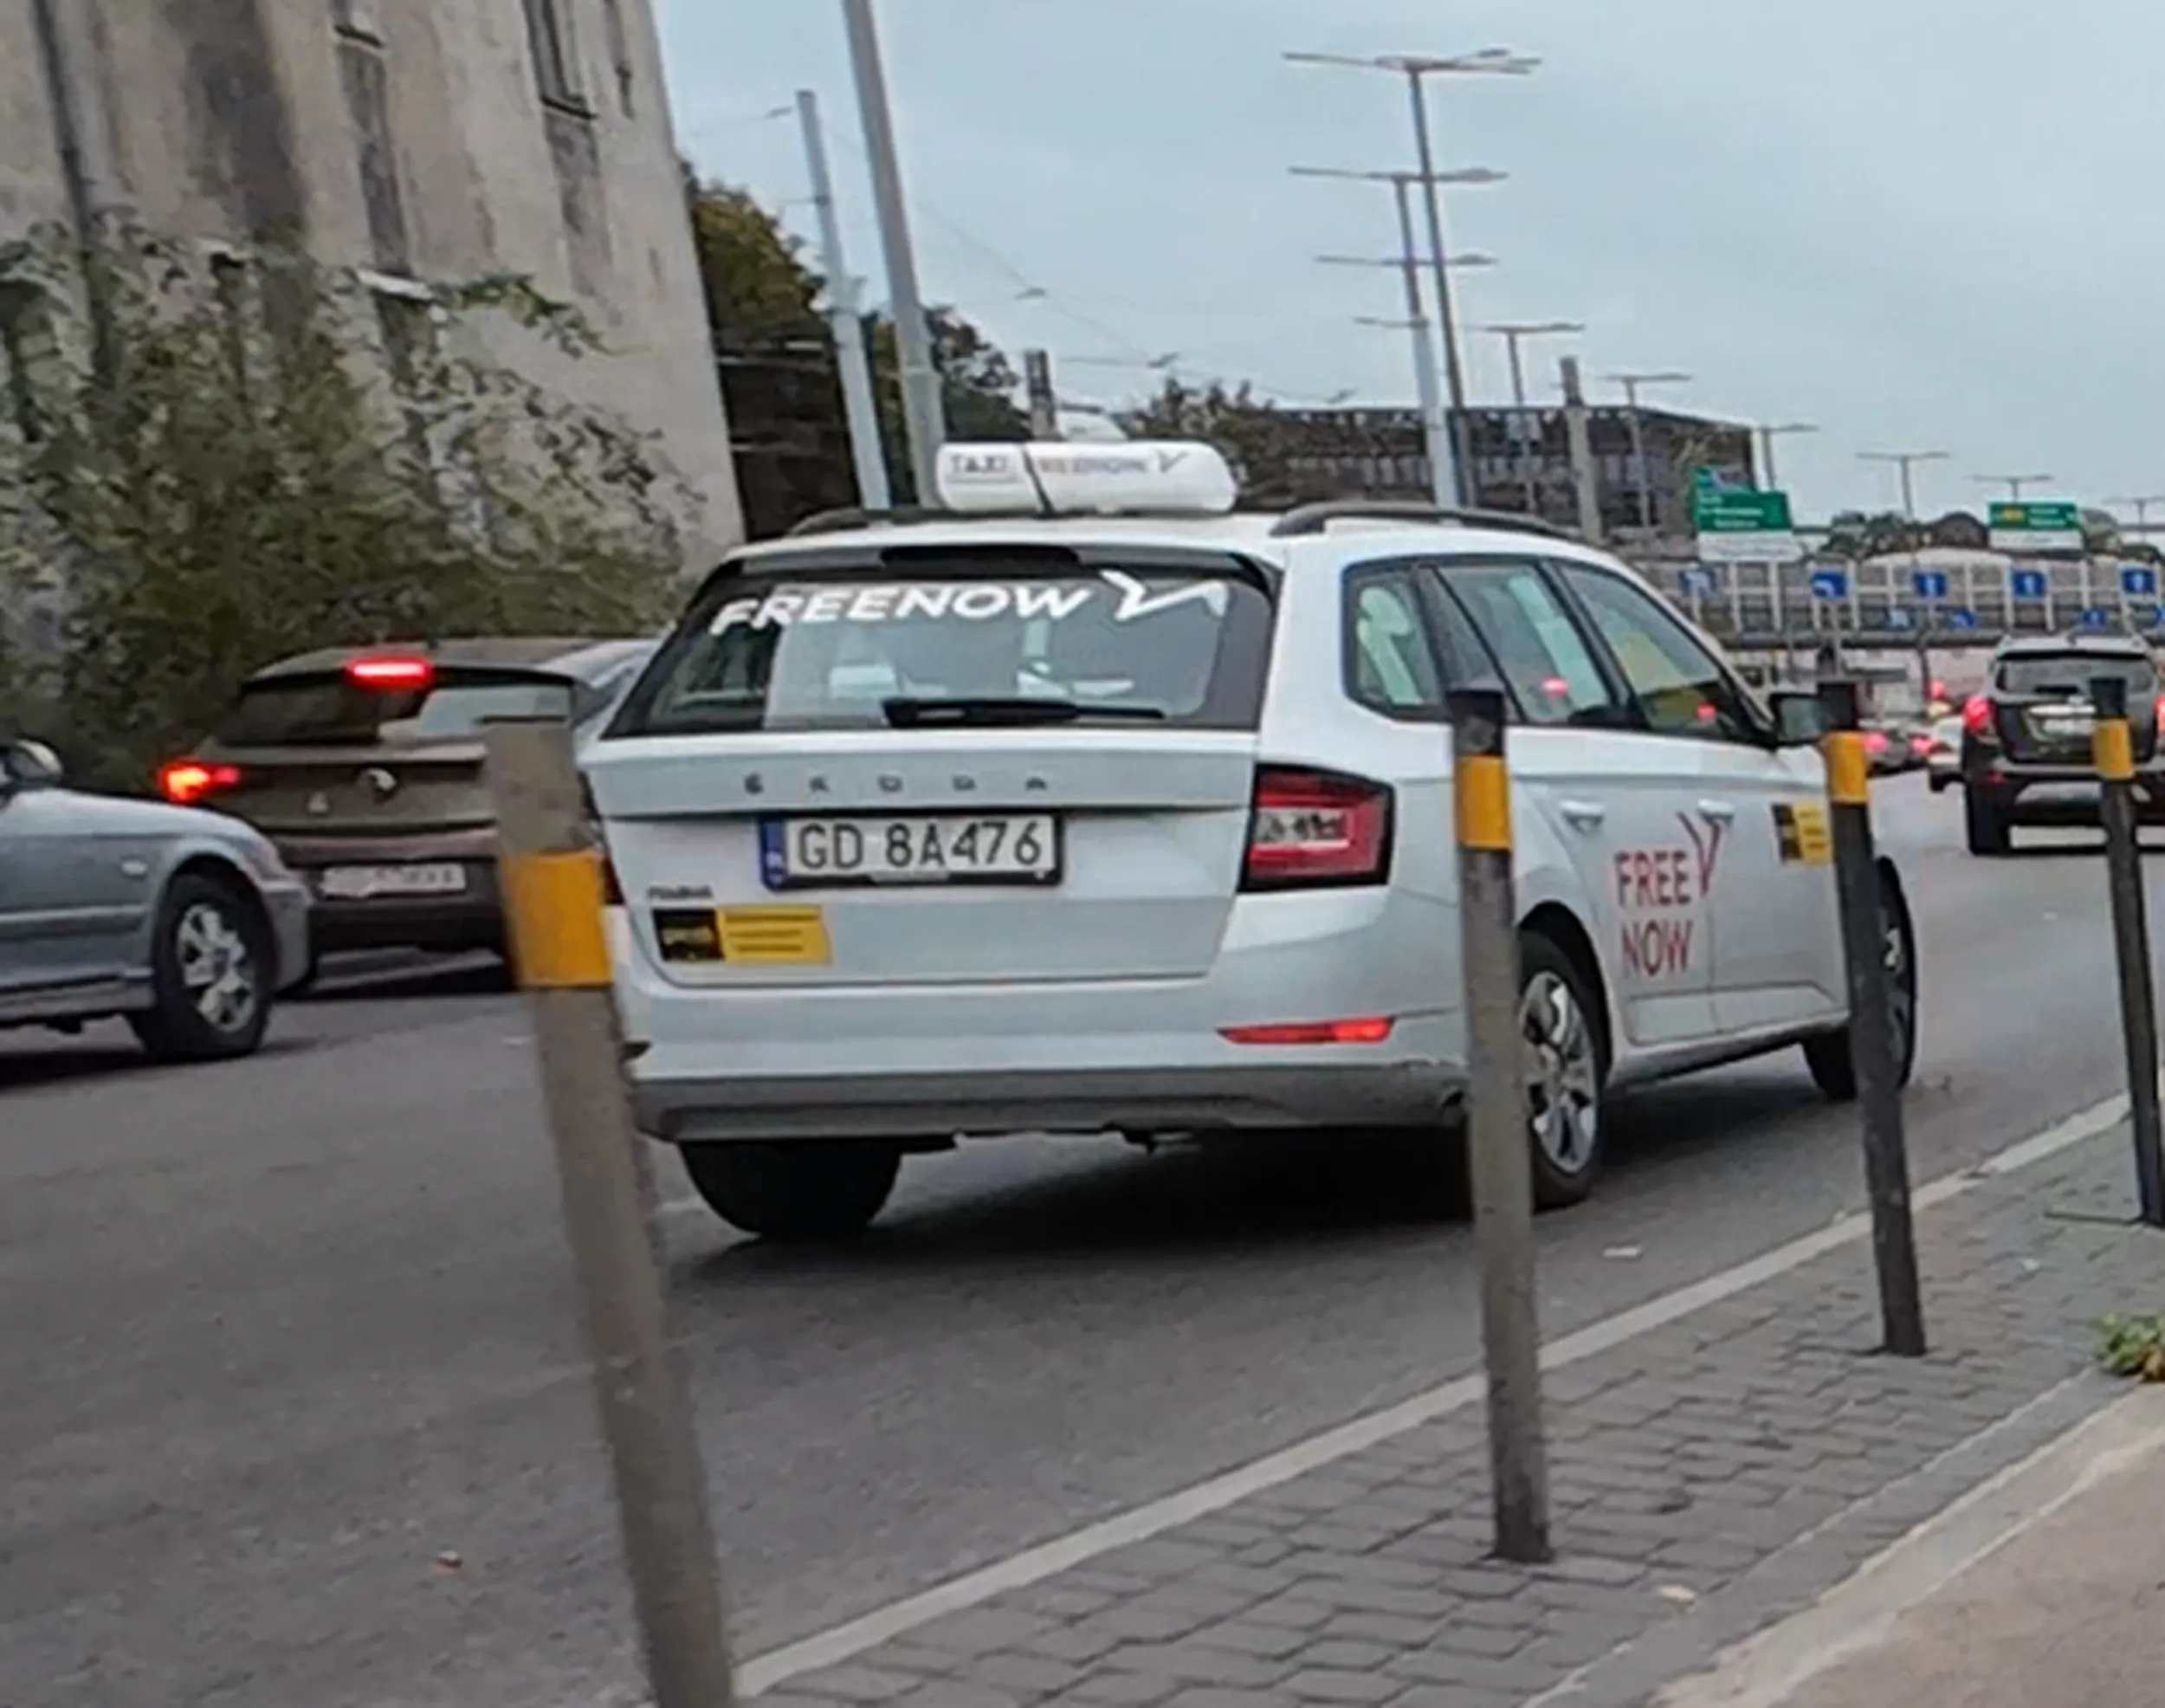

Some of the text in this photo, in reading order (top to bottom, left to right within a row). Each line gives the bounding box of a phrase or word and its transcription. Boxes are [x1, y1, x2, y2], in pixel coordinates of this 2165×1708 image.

[709, 585, 1091, 636] FREENOW
[798, 819, 1044, 870] GD 8A476
[1614, 850, 1692, 907] FREE
[1622, 919, 1695, 978] NOW
